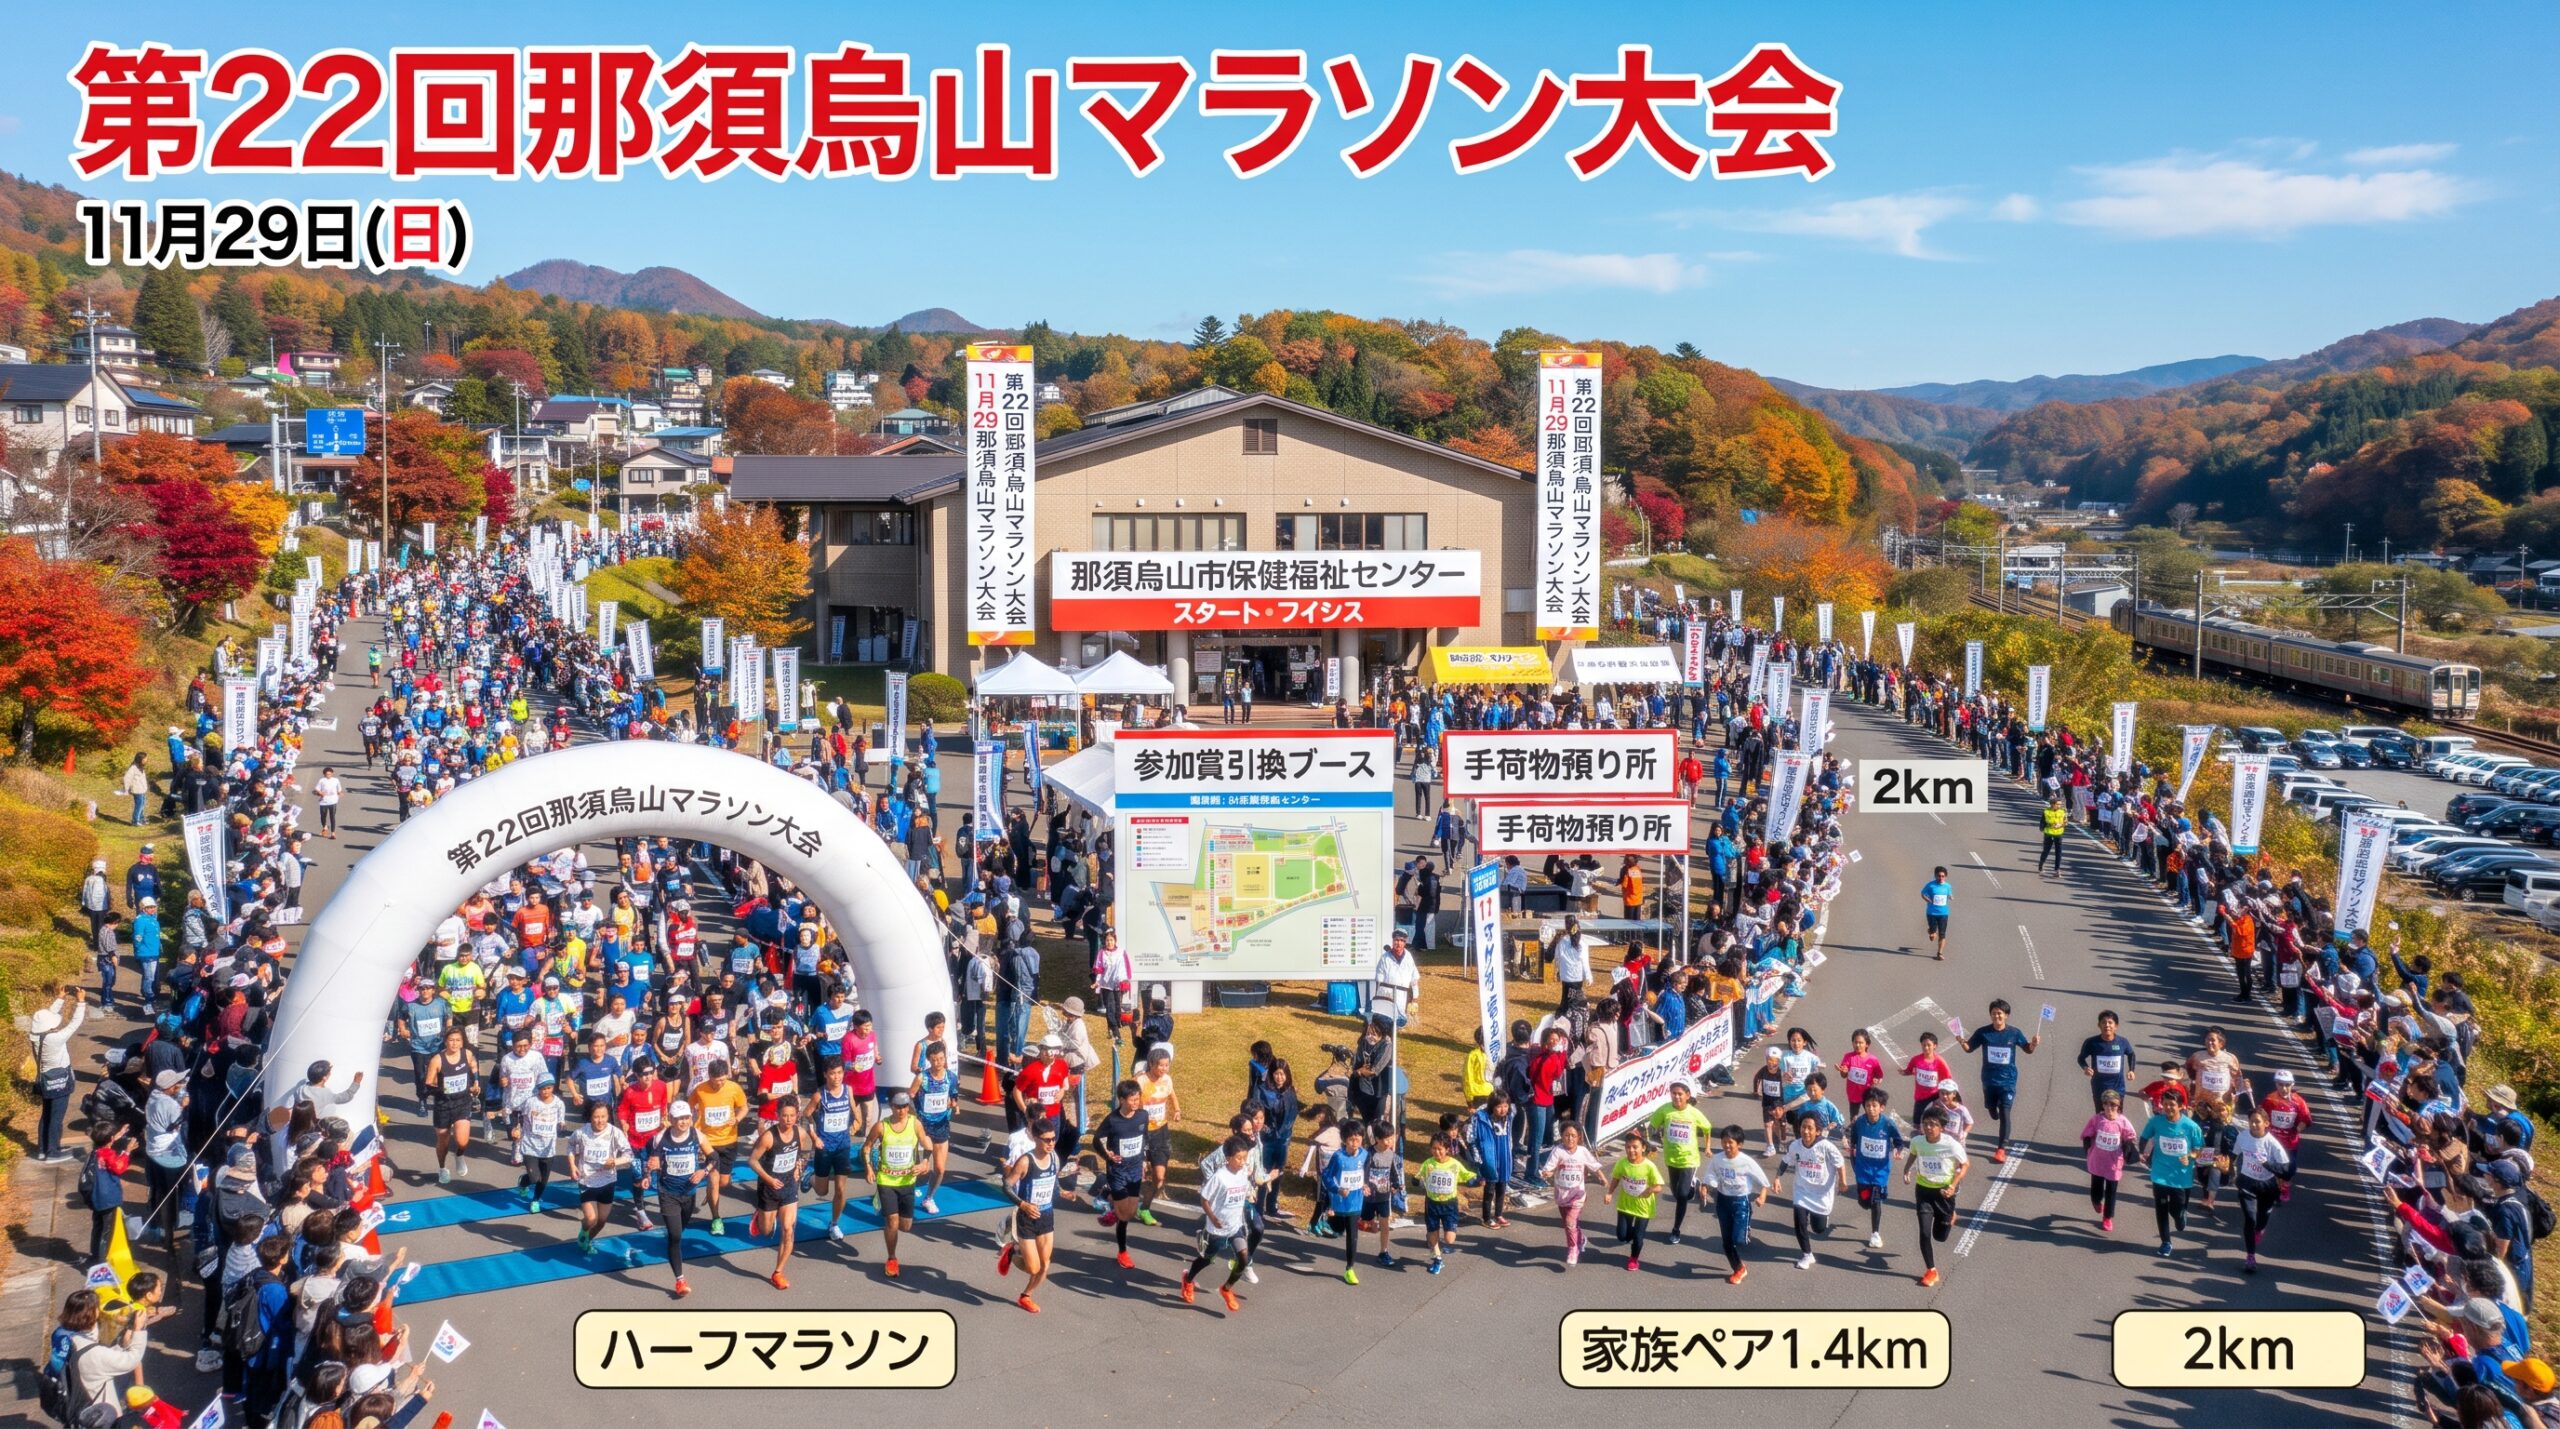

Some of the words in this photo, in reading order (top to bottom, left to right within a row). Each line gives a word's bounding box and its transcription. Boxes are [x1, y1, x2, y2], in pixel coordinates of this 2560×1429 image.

[1134, 747, 1375, 782] 参加賞引換ブース
[1464, 747, 1657, 781] 手荷物預り所
[1497, 814, 1672, 843] 手荷物預り所
